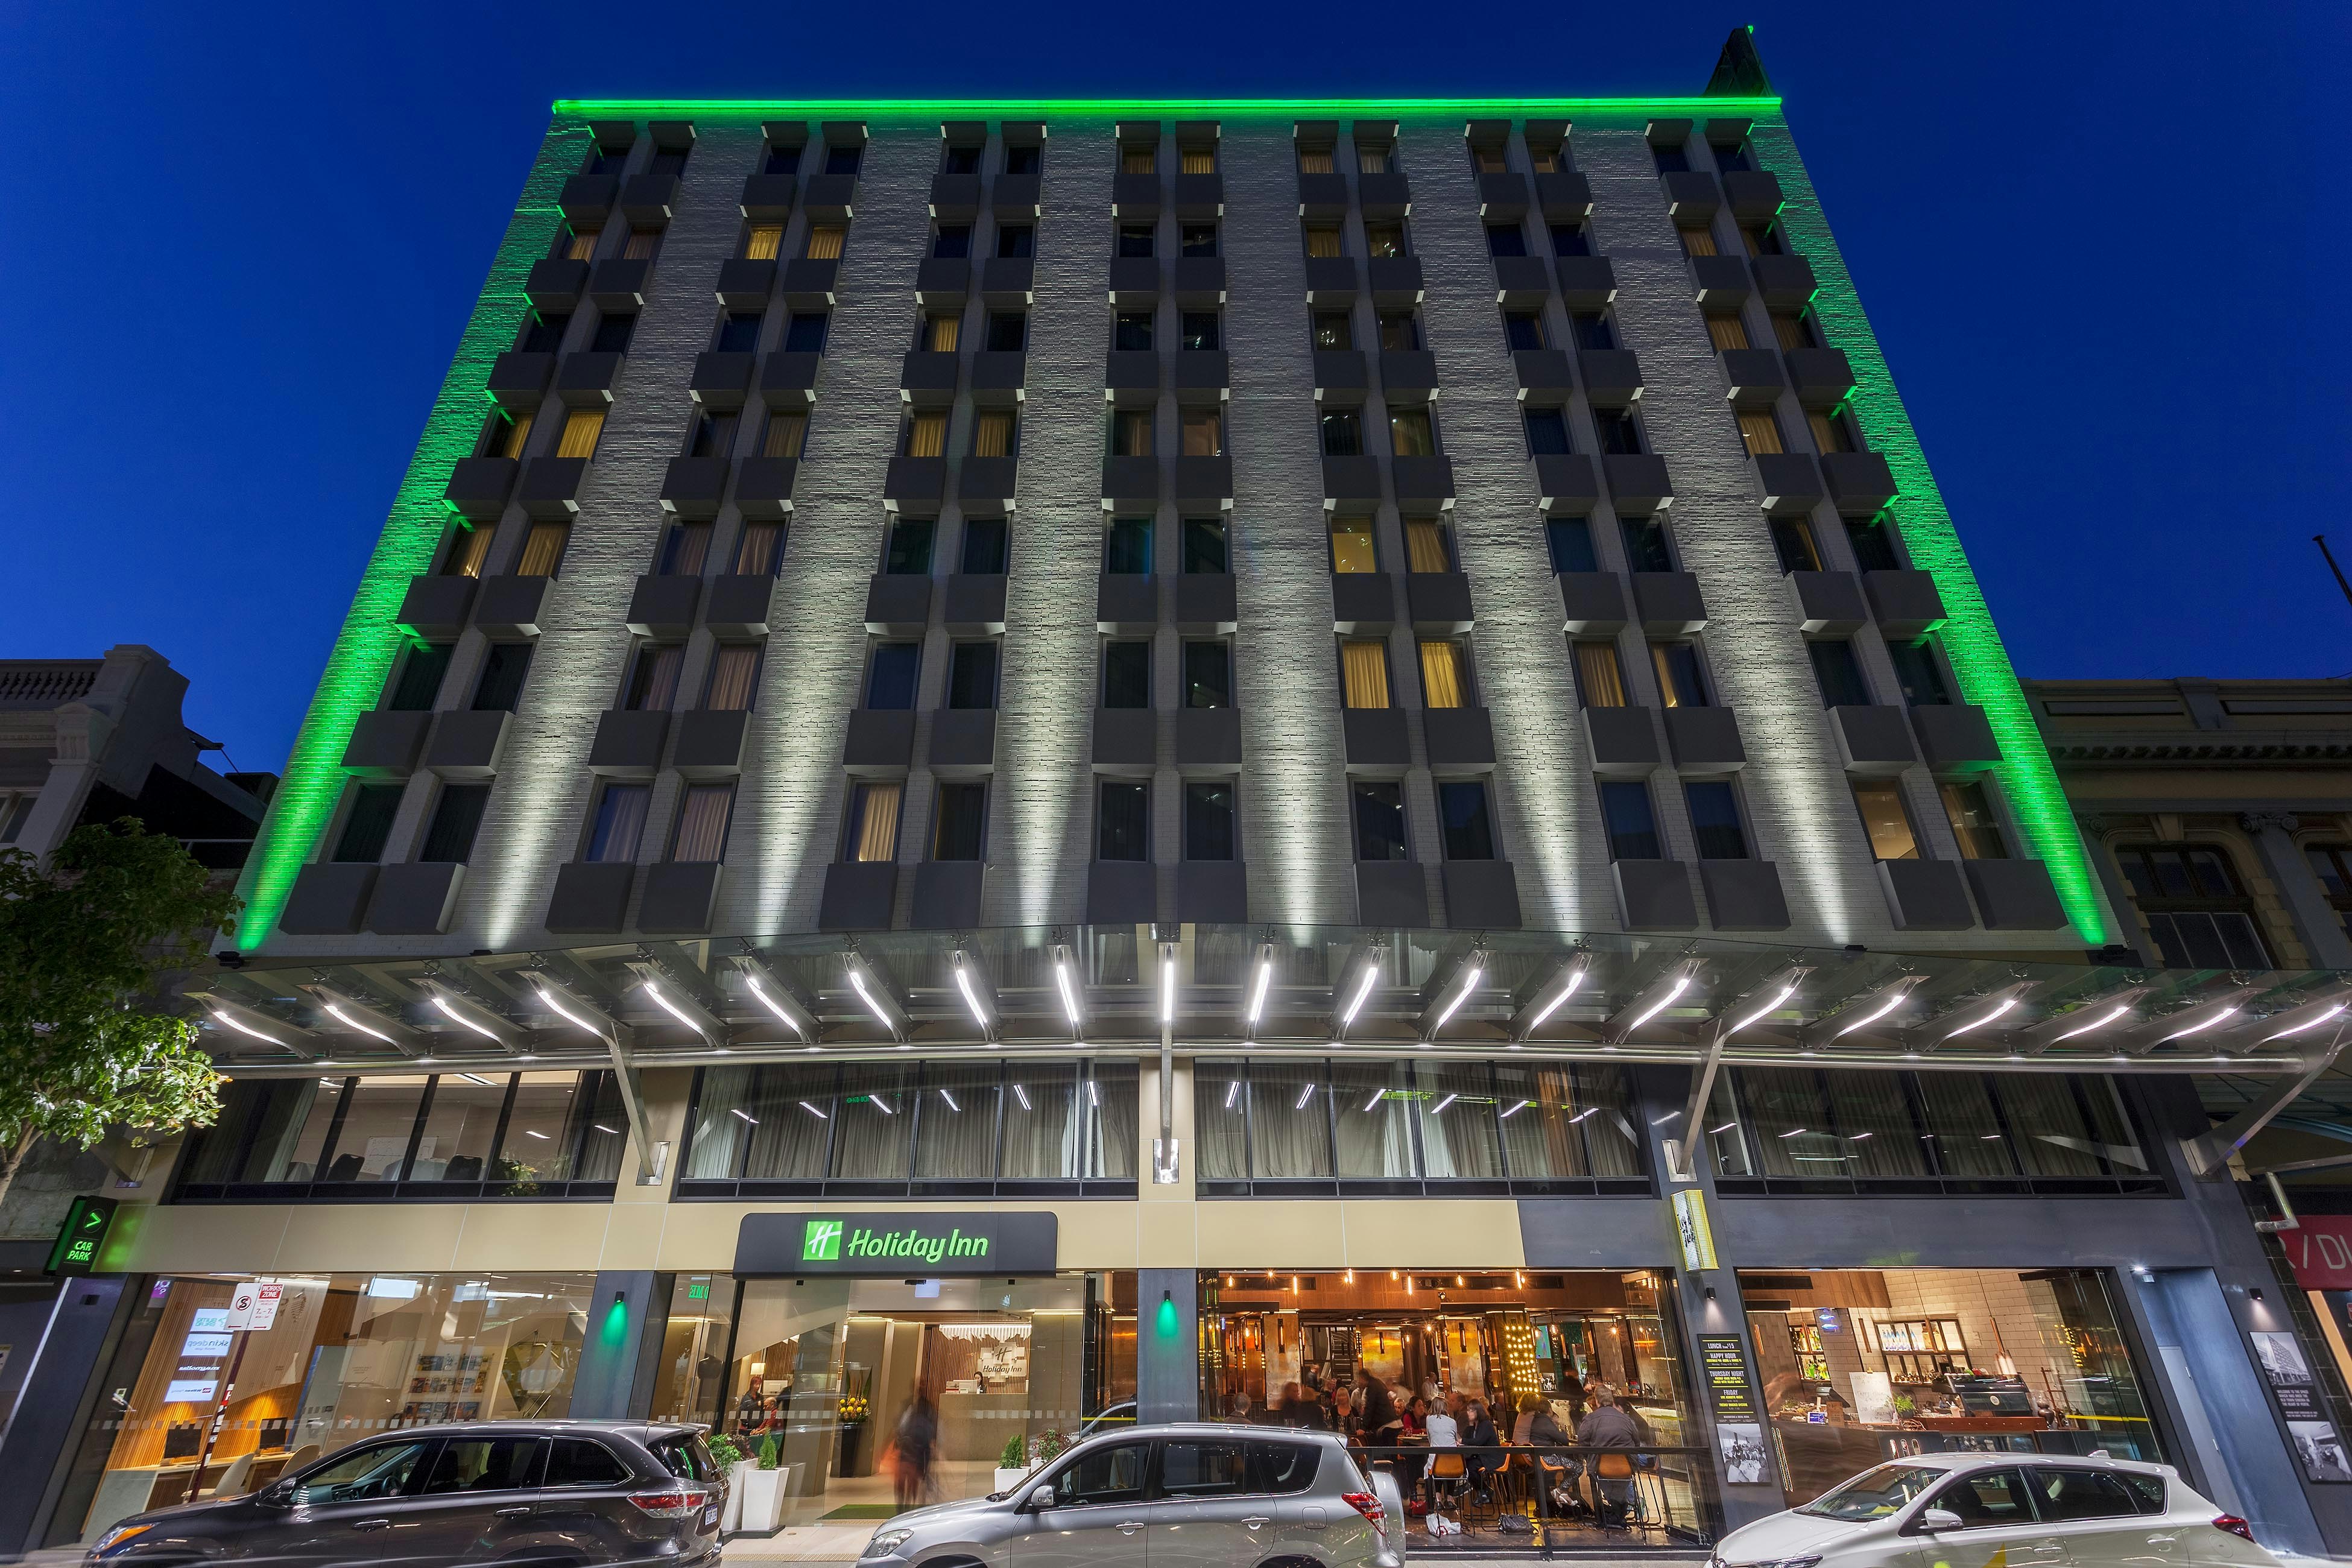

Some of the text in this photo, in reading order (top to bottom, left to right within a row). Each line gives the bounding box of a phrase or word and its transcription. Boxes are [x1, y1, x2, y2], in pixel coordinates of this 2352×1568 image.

[74, 1241, 93, 1251] CAR
[847, 1229, 946, 1263] Holiday
[947, 1228, 988, 1256] Inn
[66, 1251, 92, 1261] PARK
[982, 1364, 1010, 1374] Holiday
